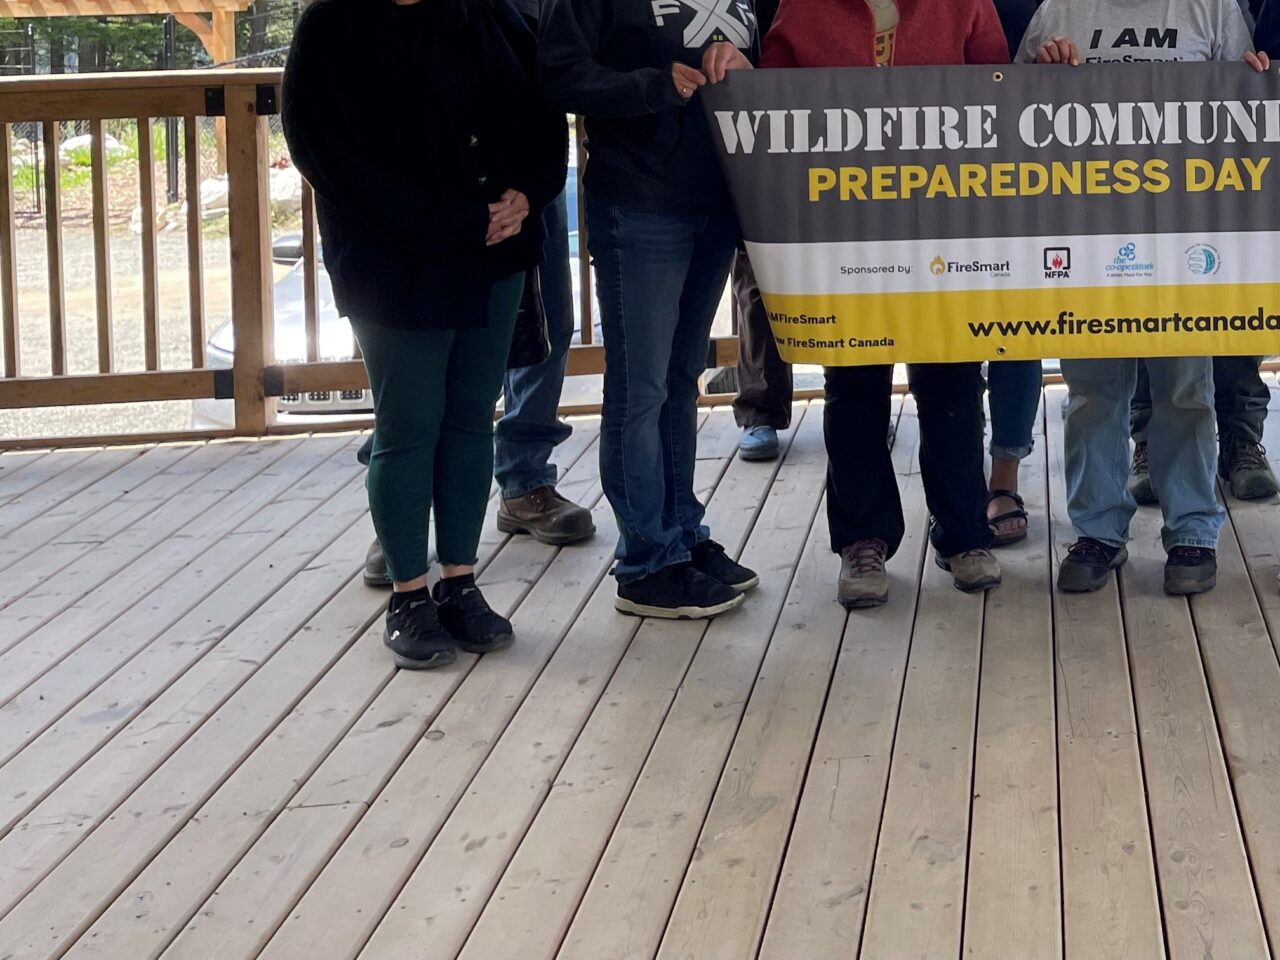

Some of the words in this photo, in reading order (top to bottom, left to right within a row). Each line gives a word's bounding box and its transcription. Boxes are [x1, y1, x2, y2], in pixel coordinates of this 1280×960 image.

[1089, 28, 1103, 50] I
[1110, 27, 1178, 49] AM
[714, 104, 997, 154] WILDFIRE
[808, 157, 1170, 202] PREPAREDNESS
[1186, 157, 1271, 192] DAY
[840, 264, 895, 275] Sponsored
[897, 264, 913, 275] by:
[947, 260, 1010, 273] FireSmart
[1044, 270, 1070, 279] NFPA
[787, 336, 845, 348] FireSmart
[848, 336, 895, 348] Canada
